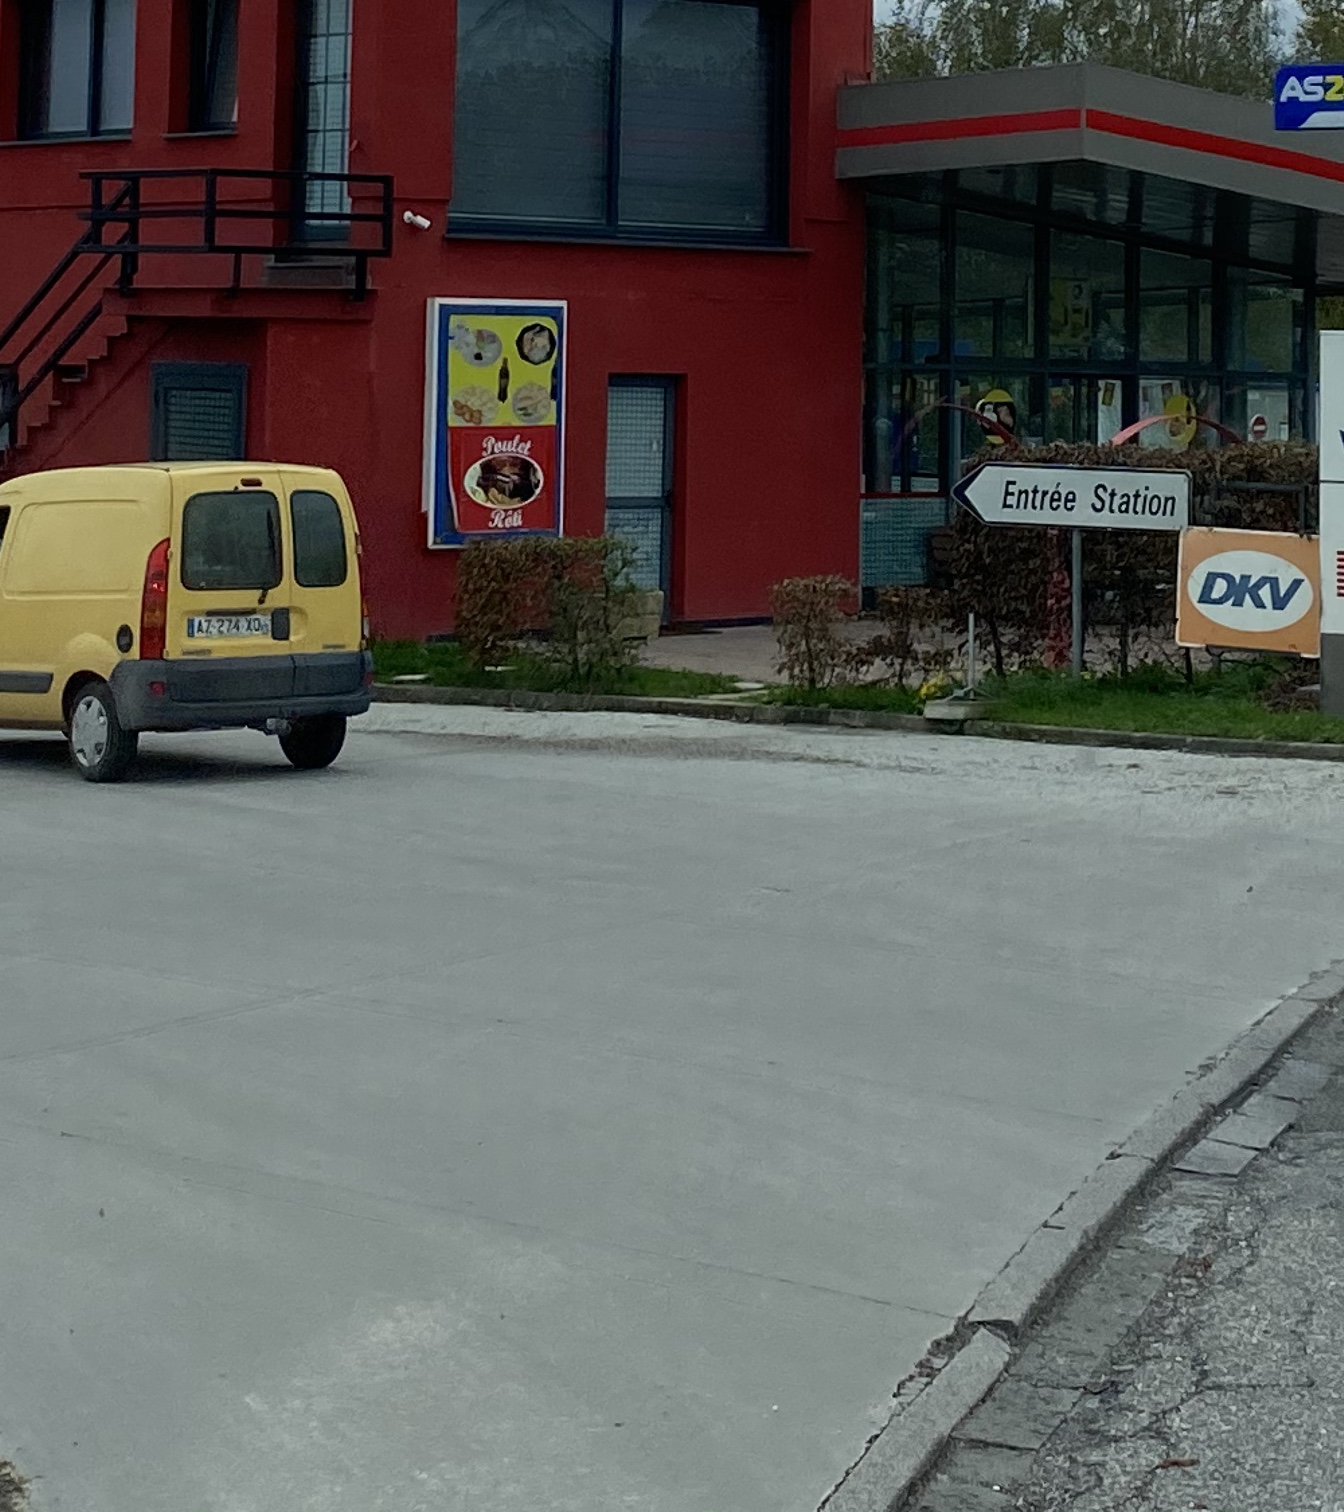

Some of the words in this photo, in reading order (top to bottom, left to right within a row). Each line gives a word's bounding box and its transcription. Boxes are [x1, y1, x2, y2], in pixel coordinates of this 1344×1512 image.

[481, 435, 533, 457] Poulet
[1001, 480, 1077, 512] Entrée
[1090, 483, 1177, 517] Station
[488, 508, 523, 528] Rôti
[1197, 571, 1305, 611] DKV
